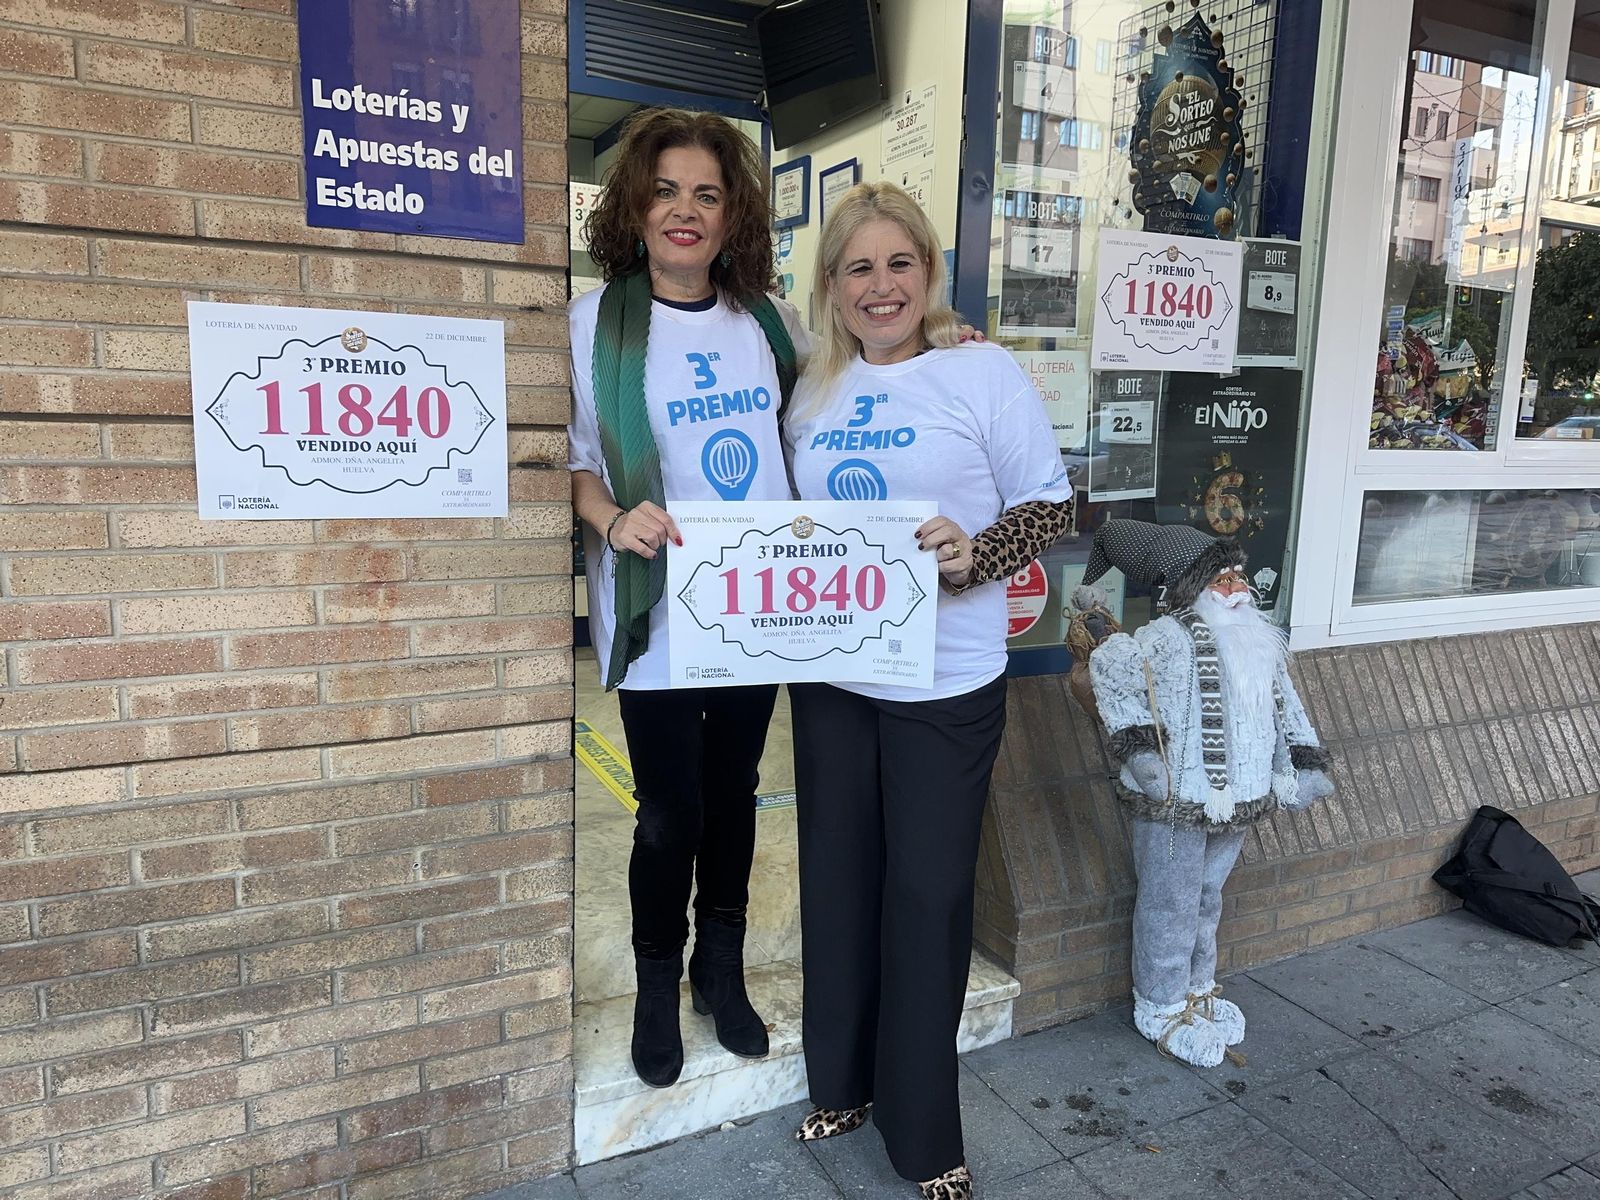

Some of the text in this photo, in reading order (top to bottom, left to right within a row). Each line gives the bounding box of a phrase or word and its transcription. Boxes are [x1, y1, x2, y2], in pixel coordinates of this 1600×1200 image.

[1035, 36, 1063, 57] BOTE
[1041, 82, 1053, 100] 4
[1186, 90, 1200, 105] EL
[311, 78, 469, 134] Loterías y
[1165, 93, 1214, 128] SORTEO
[896, 113, 918, 131] 30.287
[1168, 126, 1211, 154] NOS UNE
[313, 129, 513, 177] Apuestas del
[316, 177, 424, 214] Estado
[1030, 201, 1058, 220] BOTE
[1160, 209, 1210, 222] COMPARTIRLO
[1031, 245, 1054, 263] 17
[1265, 250, 1287, 265] BOTE
[1155, 265, 1195, 278] PREMIO
[1124, 279, 1213, 319] 11840
[1264, 286, 1282, 302] 8,9
[205, 320, 298, 332] LOTERÍA DE NAVIDAD
[1140, 318, 1195, 329] VENDIDO AQUÍ
[425, 332, 434, 340] 22
[446, 334, 487, 343] DICIEMBRE
[320, 358, 406, 376] PREMIO
[1030, 358, 1075, 374] LOTERÍA
[1032, 377, 1045, 387] DE
[1117, 378, 1142, 394] BOTE
[256, 380, 451, 439] 11840
[666, 386, 771, 426] PREMIO
[1212, 400, 1268, 432] Niño
[1112, 416, 1142, 434] 22,5
[296, 438, 417, 456] VENDIDO AQUÍ
[810, 427, 916, 451] PREMIO
[310, 457, 343, 465] ADMON.
[342, 466, 375, 474] HUELVA
[238, 495, 271, 504] LOTERÍA
[441, 489, 491, 497] COMPARTIRLO
[238, 502, 280, 510] NACIONAL
[680, 516, 755, 524] LOTERÍA DE NAVIDAD
[772, 544, 848, 558] PREMIO
[718, 564, 886, 615] 11840
[751, 611, 854, 629] VENDIDO AQUÍ
[762, 630, 789, 638] ADMON.
[788, 637, 816, 645] HUELVA
[872, 657, 919, 667] COMPARTIRLO
[701, 671, 735, 679] NACIONAL
